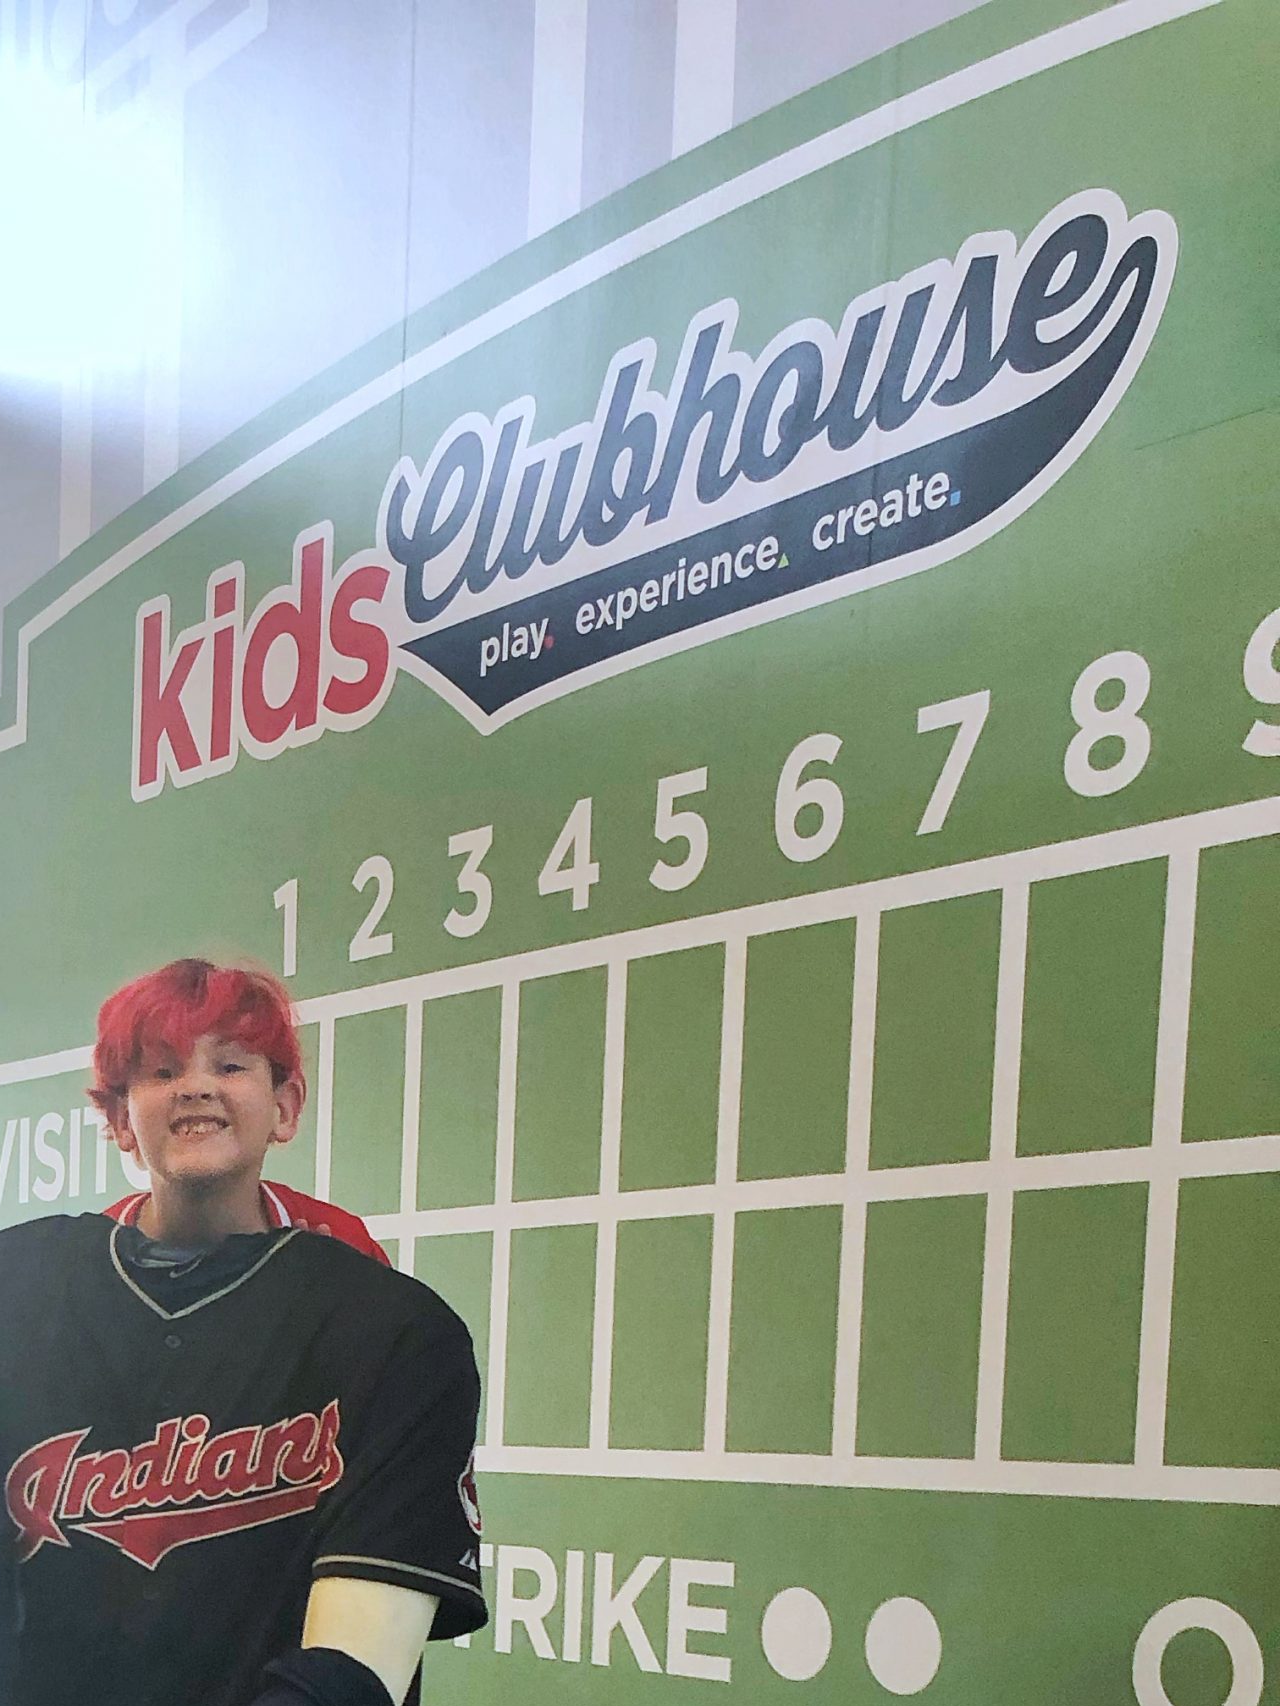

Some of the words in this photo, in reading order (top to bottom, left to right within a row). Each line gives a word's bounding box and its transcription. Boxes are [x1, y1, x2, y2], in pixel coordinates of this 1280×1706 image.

[139, 538, 393, 787] kids
[384, 210, 1146, 624] Clubhouse
[273, 879, 298, 977] 1
[349, 855, 394, 962] 2
[443, 824, 494, 939] 3
[537, 797, 600, 912] 4
[648, 767, 709, 892] 5
[774, 732, 844, 863] 6
[917, 690, 991, 835] 7
[1063, 650, 1152, 797] 8
[5, 1398, 344, 1564] Indians
[454, 1543, 736, 1683] RIKE
